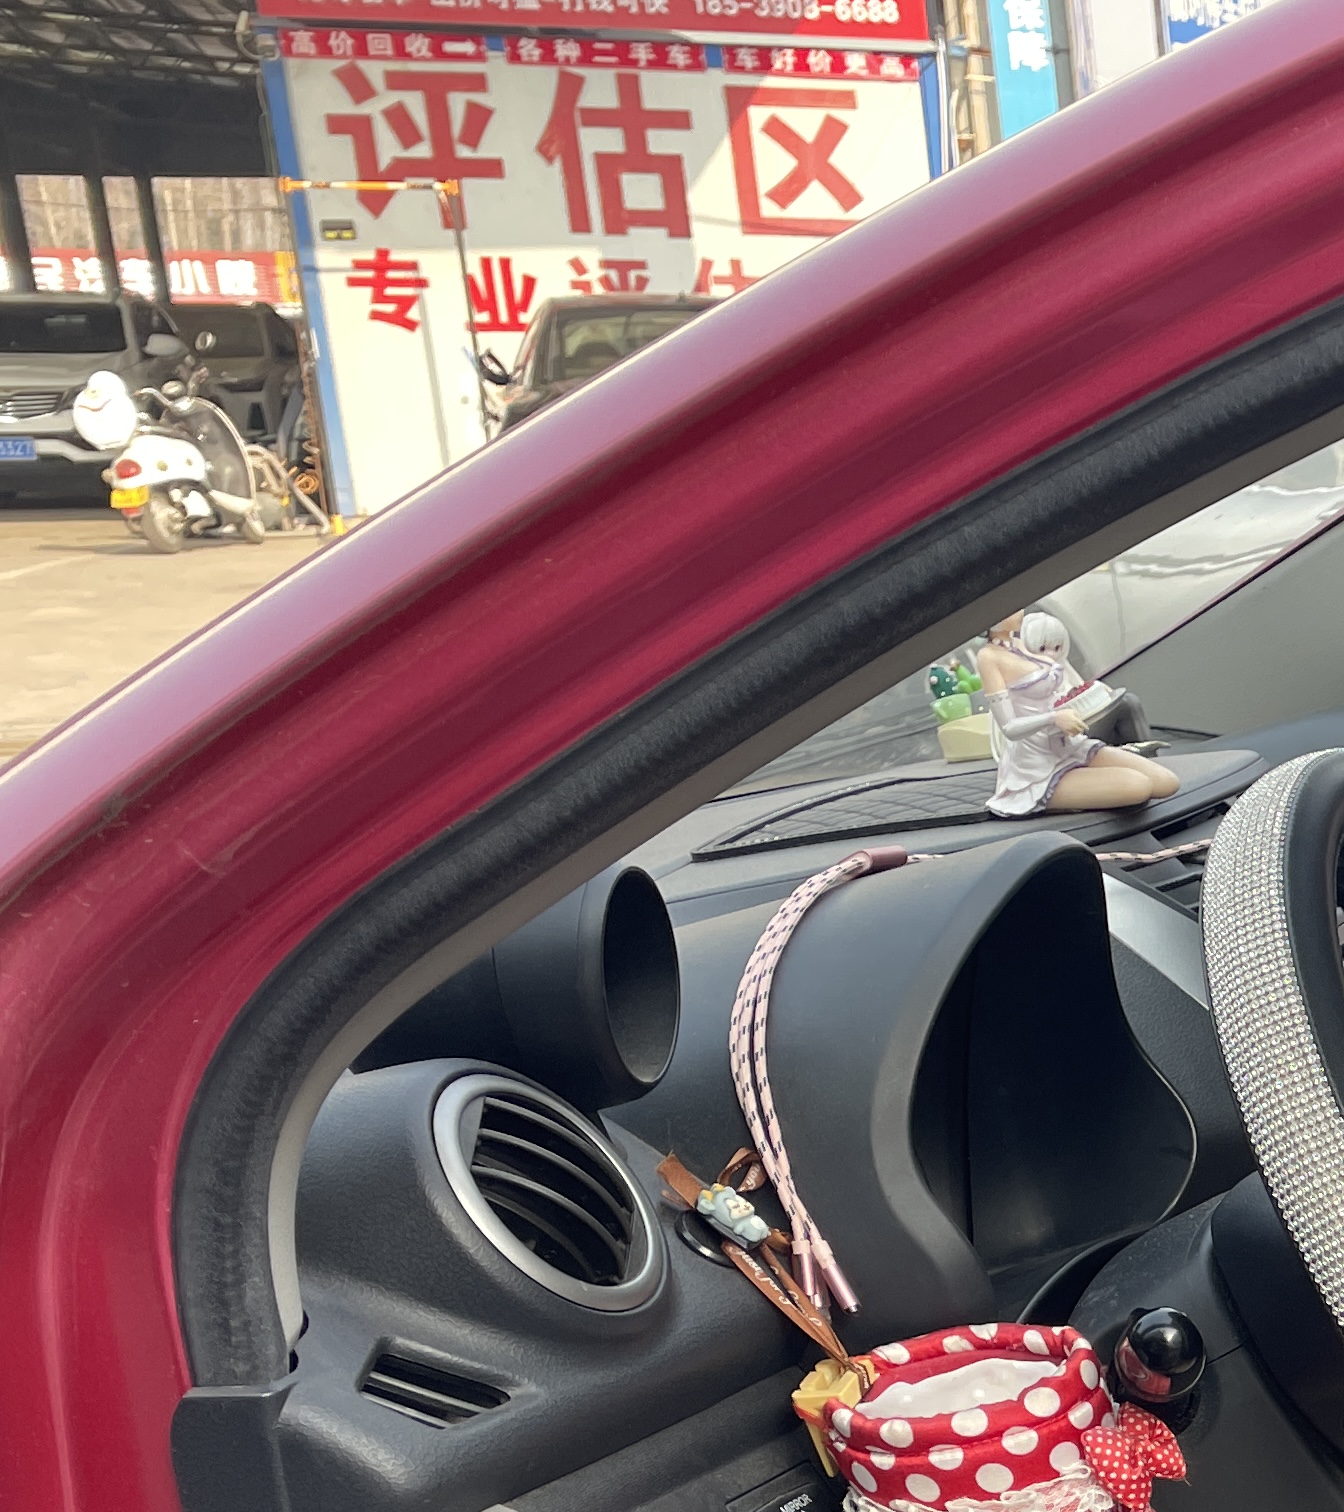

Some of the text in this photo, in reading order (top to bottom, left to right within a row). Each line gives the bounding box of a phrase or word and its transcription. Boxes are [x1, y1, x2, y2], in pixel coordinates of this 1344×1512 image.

[289, 30, 433, 59] 高价回收
[516, 37, 693, 69] 各种二手车
[326, 59, 863, 239] 评估区
